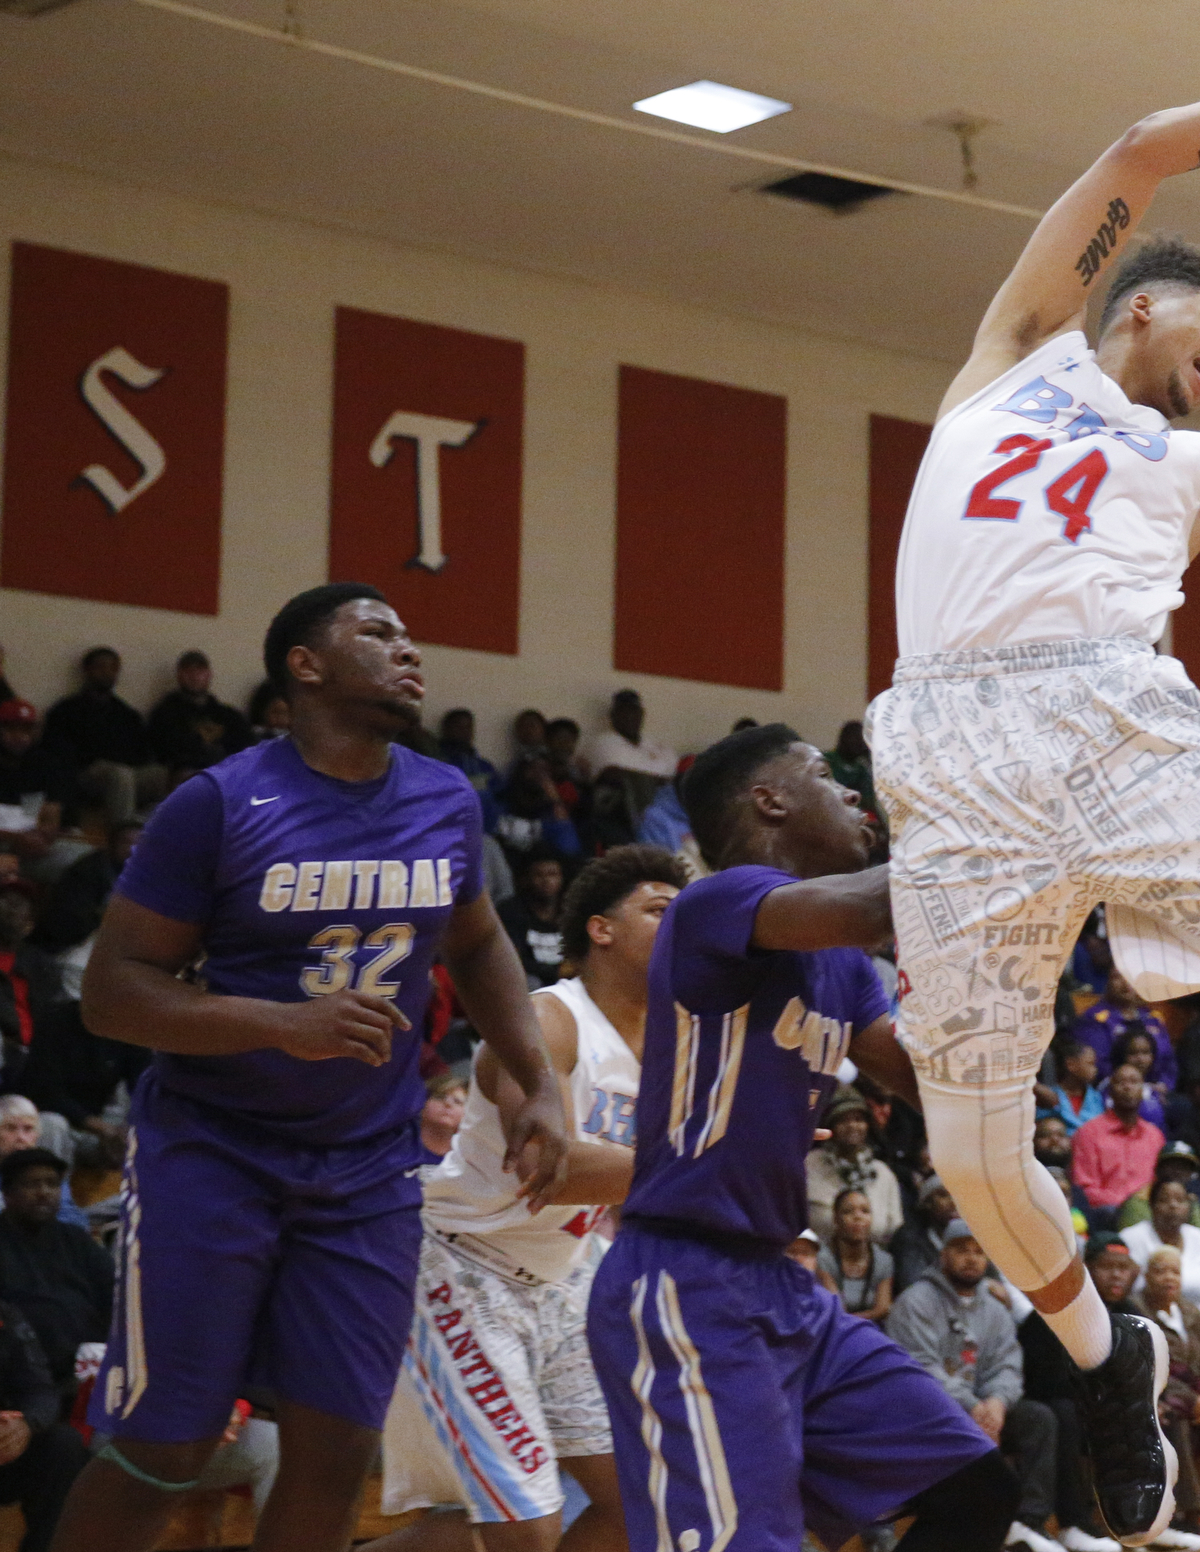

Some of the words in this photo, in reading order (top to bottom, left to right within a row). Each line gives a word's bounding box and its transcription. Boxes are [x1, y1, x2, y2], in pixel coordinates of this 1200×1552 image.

[1075, 197, 1130, 287] GAME
[69, 346, 170, 515] S
[368, 410, 488, 574] T
[961, 432, 1111, 547] 24
[299, 922, 417, 999] 32
[983, 922, 1060, 949] FIGHT
[427, 1280, 549, 1474] PANTHERS
